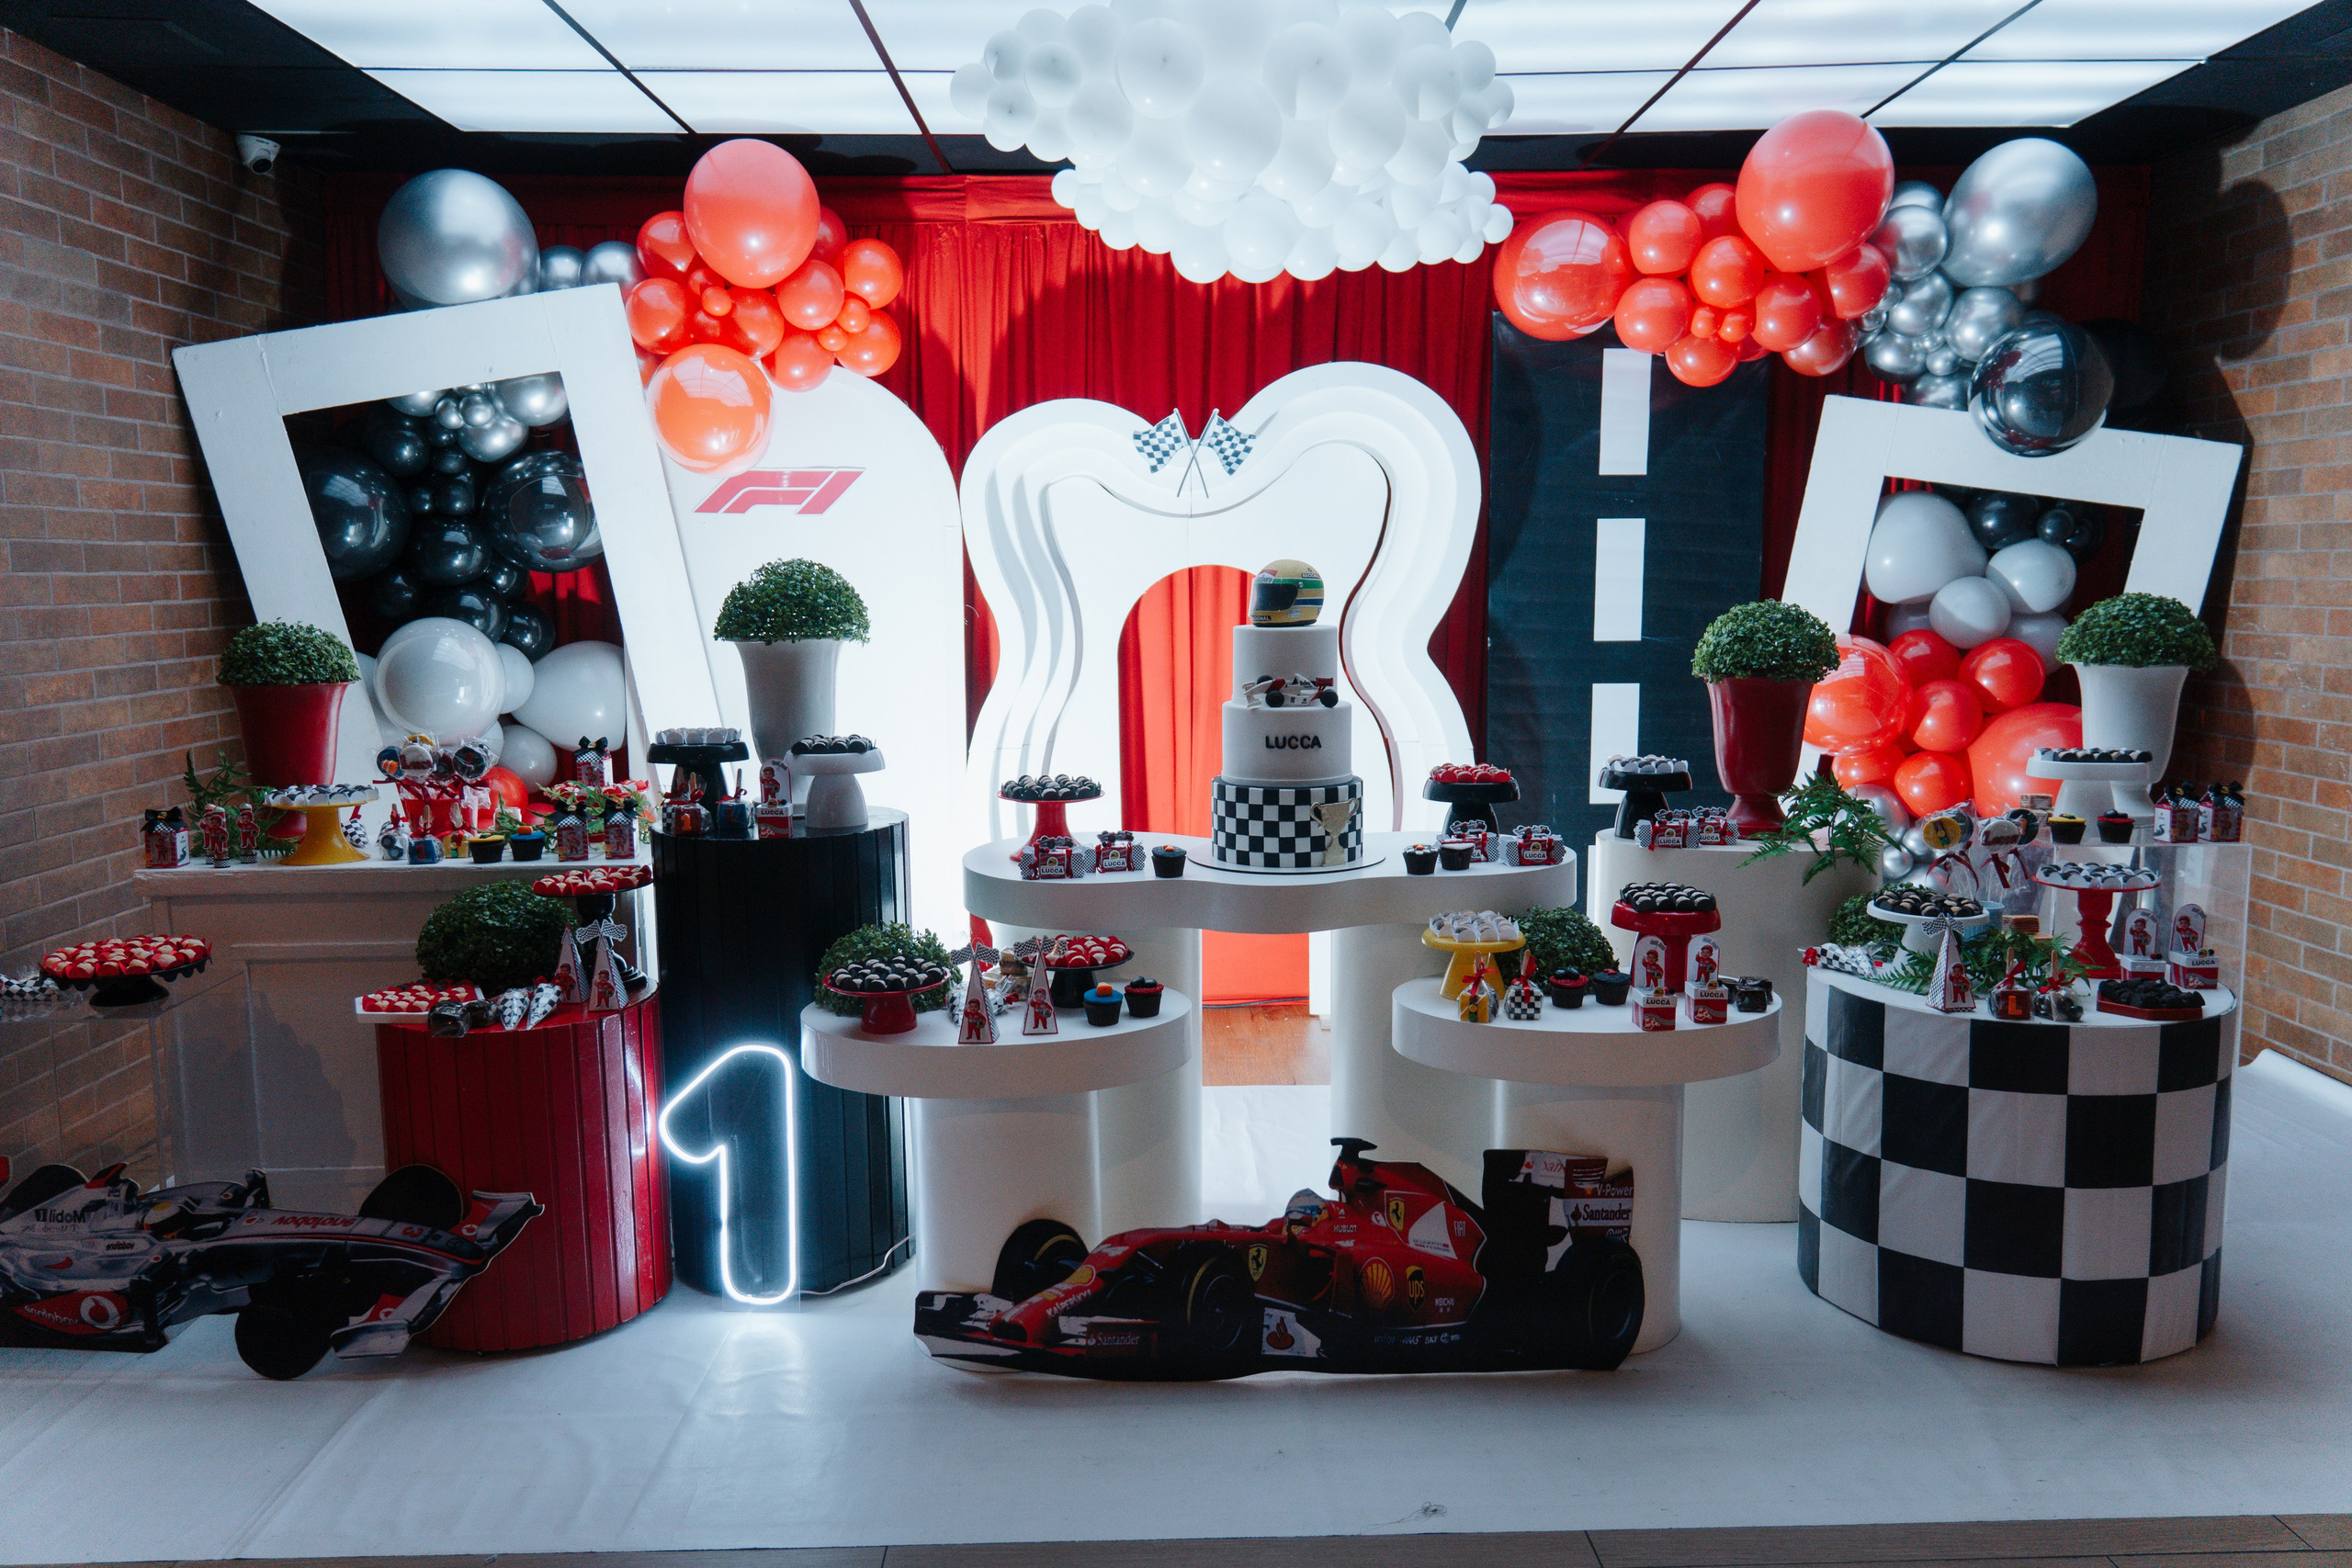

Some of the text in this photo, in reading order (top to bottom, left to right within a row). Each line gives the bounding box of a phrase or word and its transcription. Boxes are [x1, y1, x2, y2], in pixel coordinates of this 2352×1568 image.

[694, 470, 864, 514] F1
[1265, 735, 1322, 750] LUCCA
[680, 813, 692, 831] 1
[2007, 995, 2022, 1015] L
[659, 1044, 796, 1304] 1
[1596, 1183, 1633, 1197] V-Power
[1582, 1202, 1632, 1221] Santander
[1333, 1224, 1357, 1233] HUBLOT
[1453, 1220, 1466, 1236] FIAT
[1408, 1280, 1425, 1305] ups
[1096, 1332, 1140, 1346] Santander
